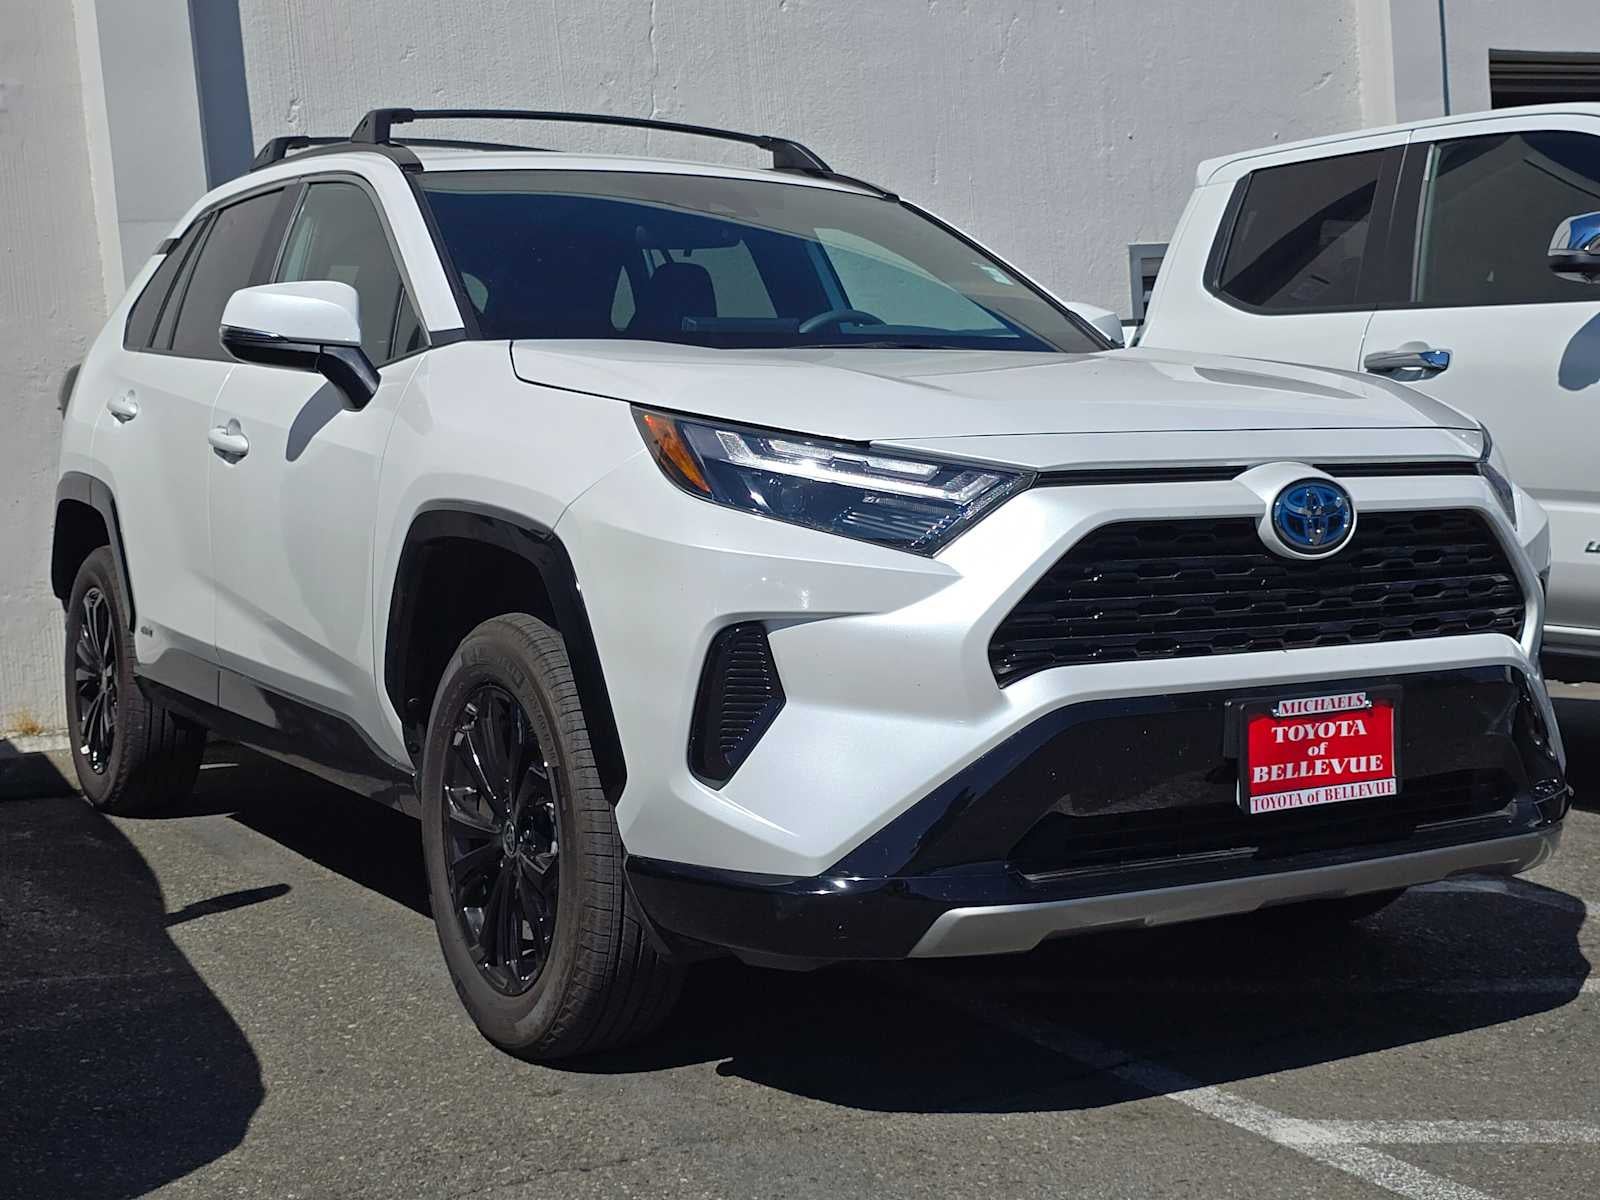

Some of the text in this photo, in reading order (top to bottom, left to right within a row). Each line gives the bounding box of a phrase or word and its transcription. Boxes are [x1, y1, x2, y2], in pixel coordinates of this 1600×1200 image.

[1281, 694, 1364, 714] MICHAELS
[1271, 719, 1367, 744] TOYOTA
[1307, 742, 1329, 757] of
[1253, 754, 1383, 783] BELLEVUE
[1253, 780, 1393, 812] TOYOTA of BELLEVUE
